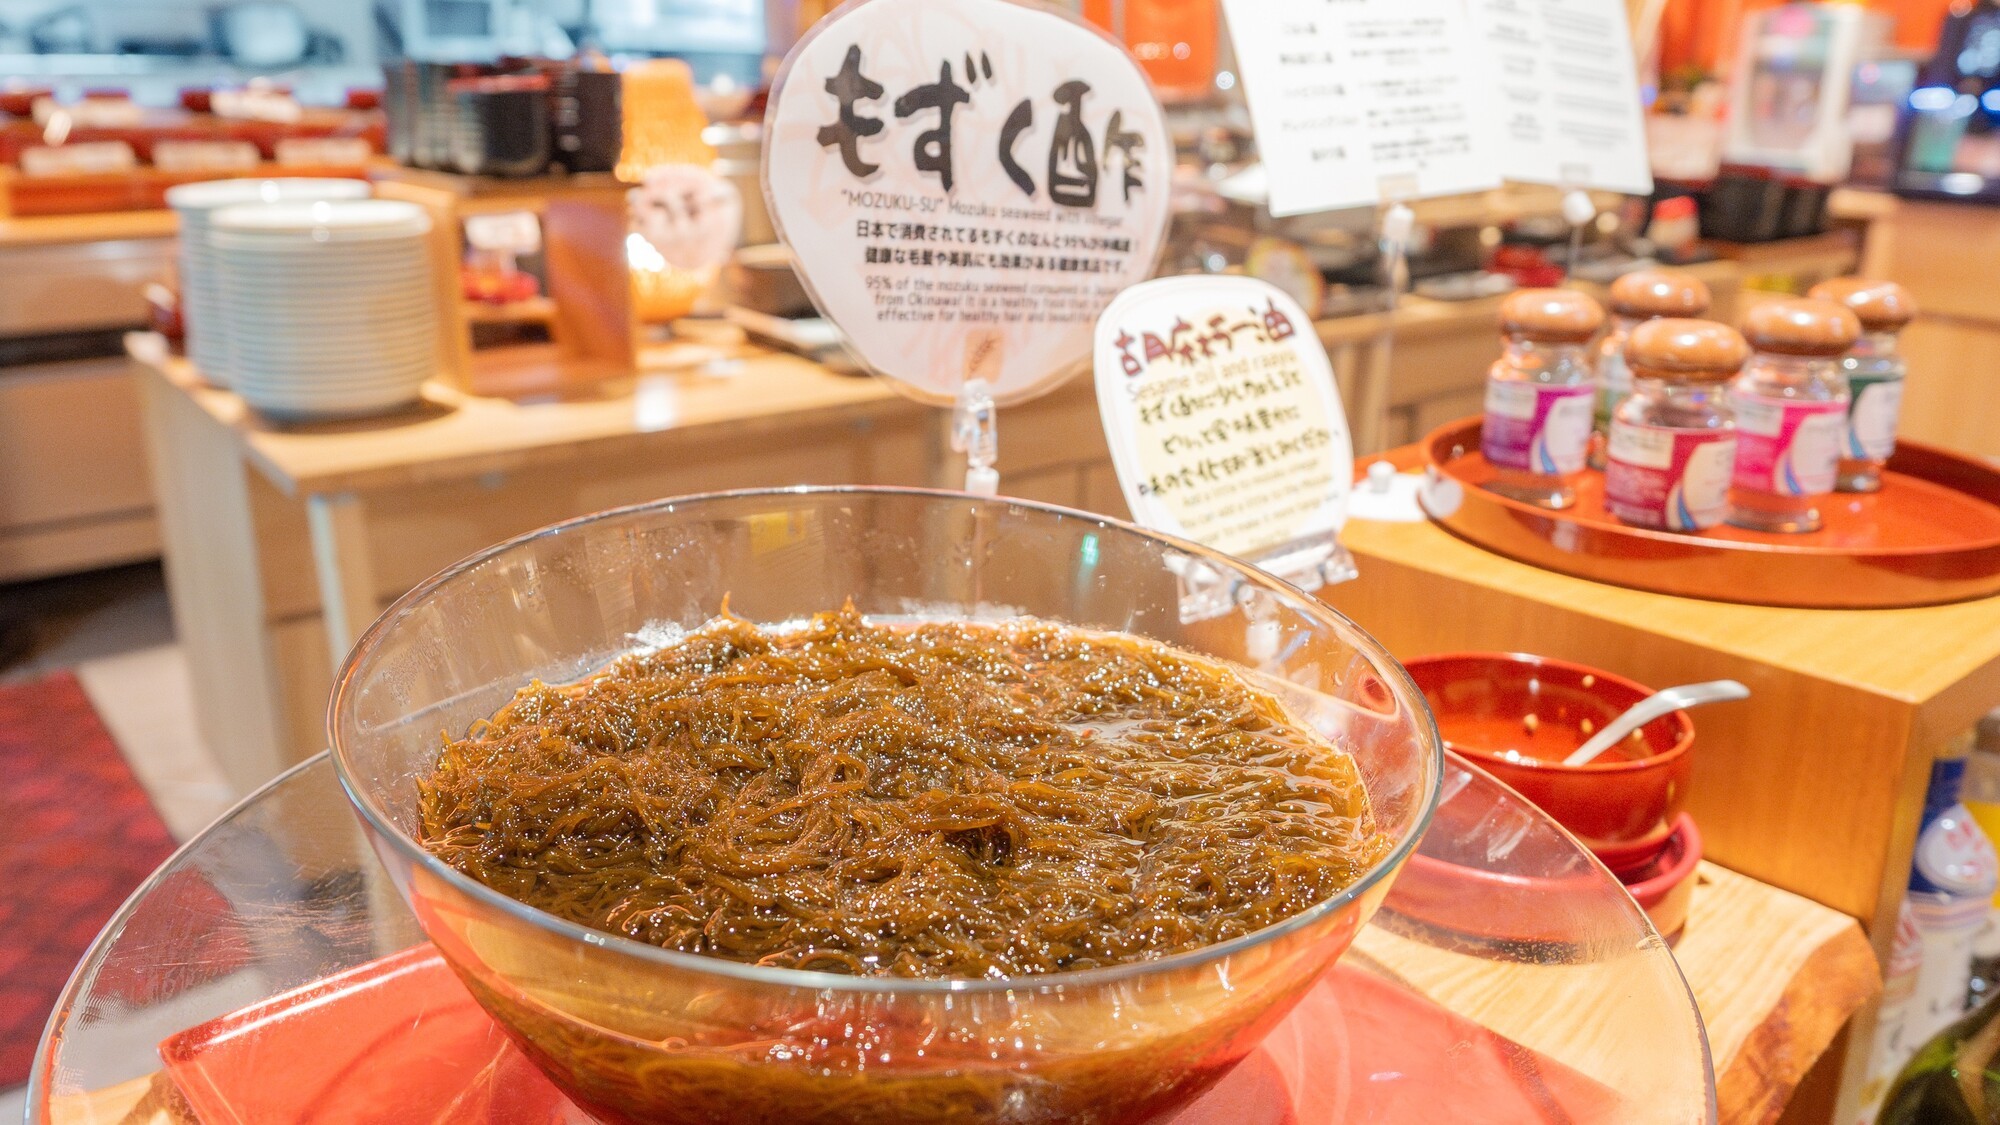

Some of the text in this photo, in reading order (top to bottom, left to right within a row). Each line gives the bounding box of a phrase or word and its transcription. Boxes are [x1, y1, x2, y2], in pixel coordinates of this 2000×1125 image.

[817, 43, 1145, 207] もずく酢
[949, 201, 997, 217] Mozuku
[865, 275, 892, 290] 95%
[896, 276, 910, 290] of
[914, 278, 933, 291] the
[939, 280, 978, 292] mozuku
[875, 293, 903, 306] from
[877, 308, 934, 321] effective
[939, 309, 955, 321] for
[960, 309, 999, 324] healthy
[1126, 374, 1190, 401] Sesame
[1222, 358, 1250, 379] and
